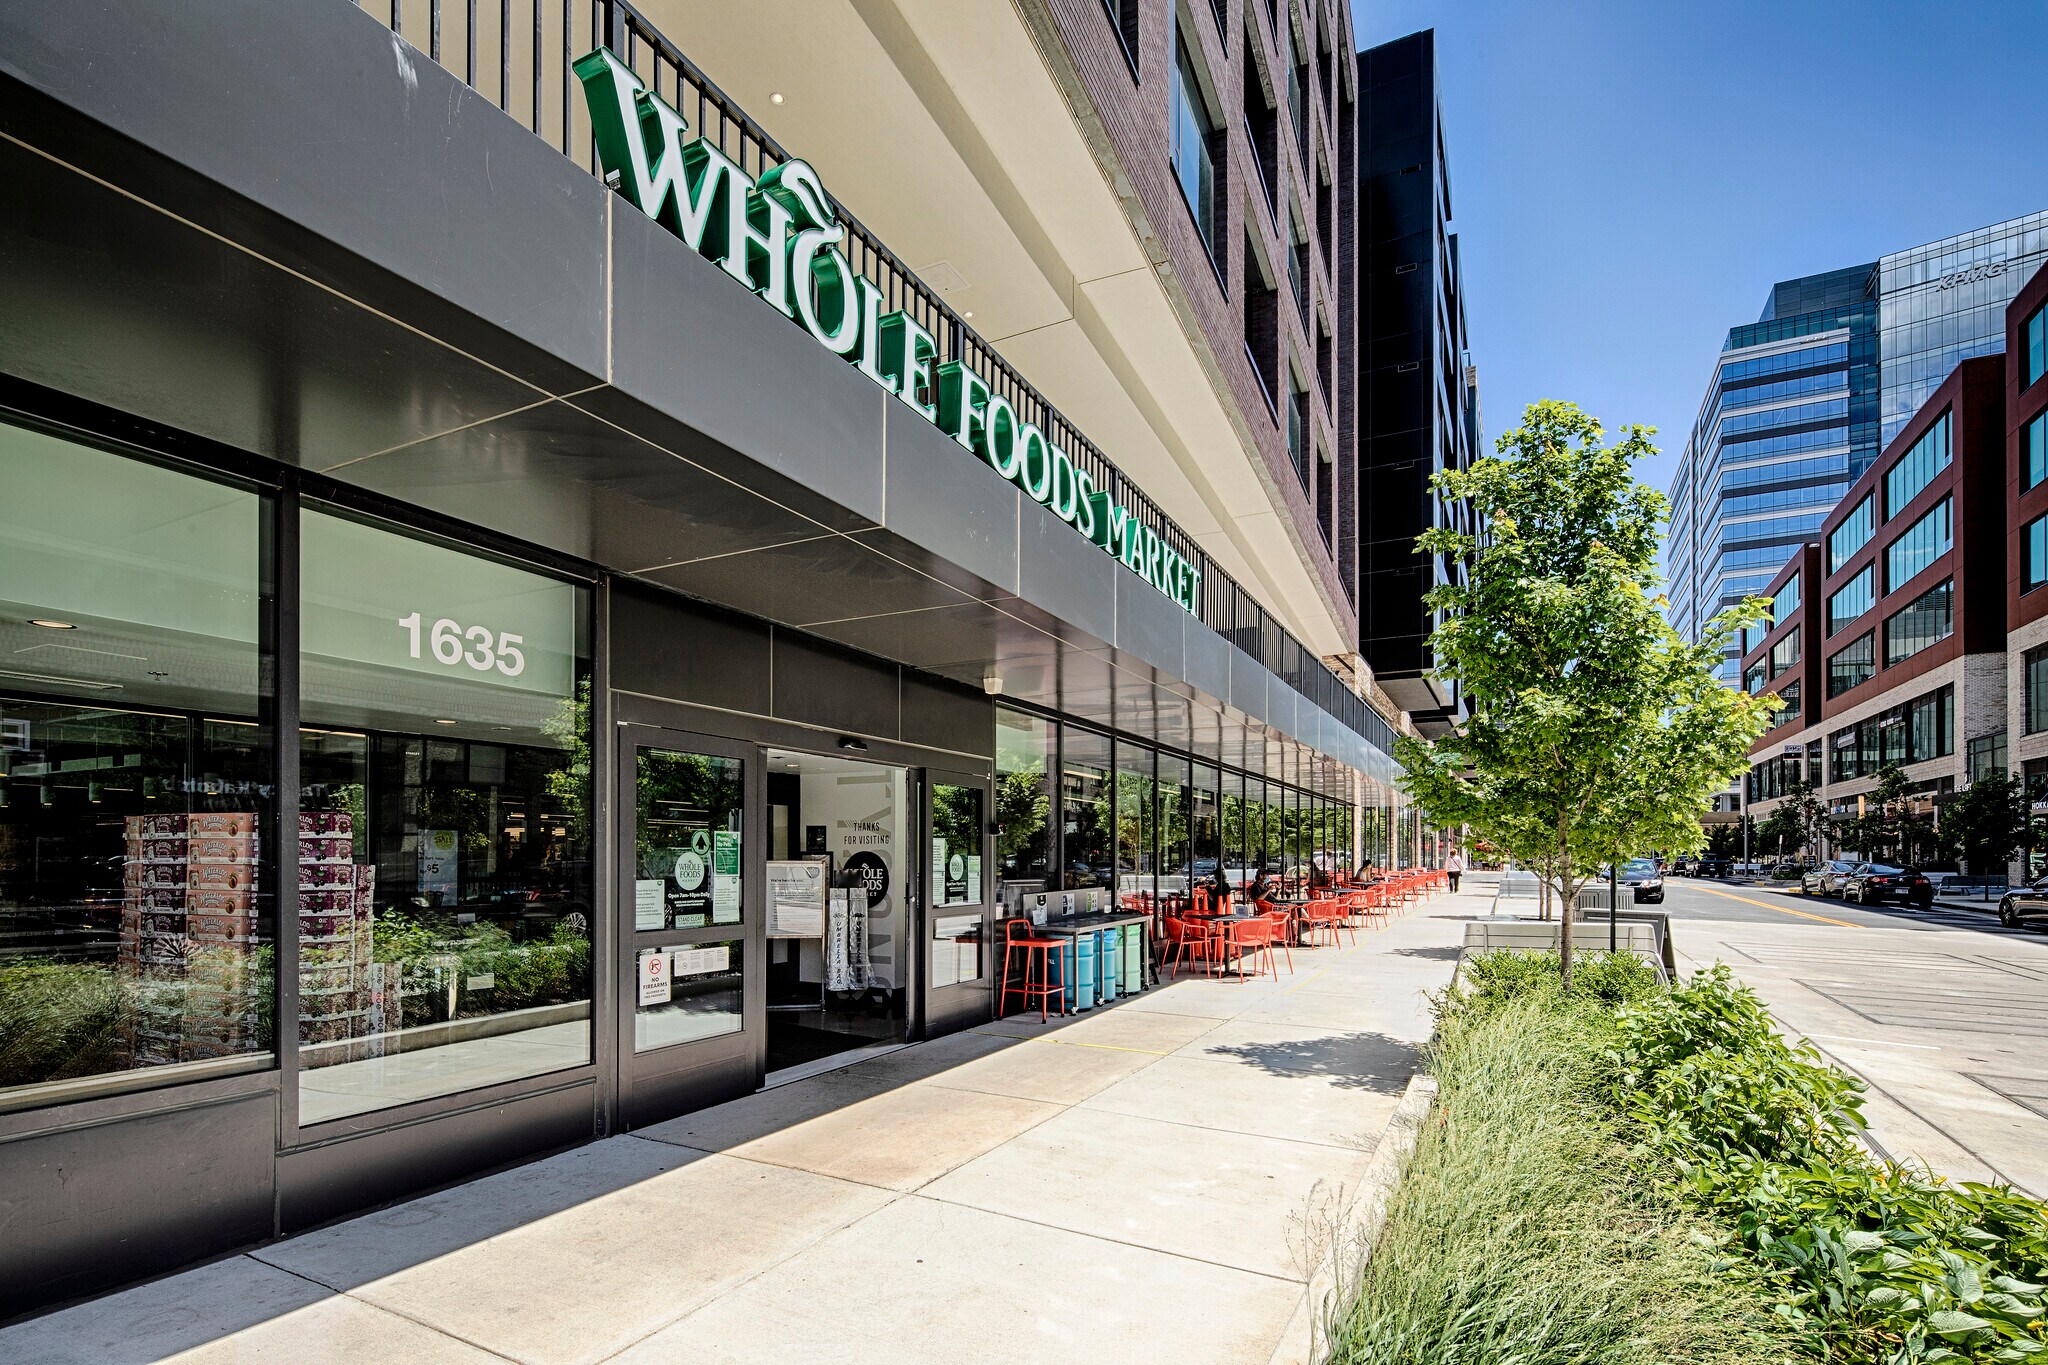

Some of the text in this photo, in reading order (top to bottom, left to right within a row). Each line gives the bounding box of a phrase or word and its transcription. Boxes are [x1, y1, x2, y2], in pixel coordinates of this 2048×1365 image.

[1936, 262, 2008, 292] KPMG
[574, 45, 1201, 620] WHOLE FOODS MARKET
[399, 612, 525, 677] 1635
[2031, 801, 2048, 810] HOKK
[854, 822, 880, 831] THANKS
[844, 835, 890, 845] FOR VISITING
[680, 870, 701, 878] FOODS
[862, 879, 882, 890] ODS
[643, 982, 667, 990] FIREARMS
